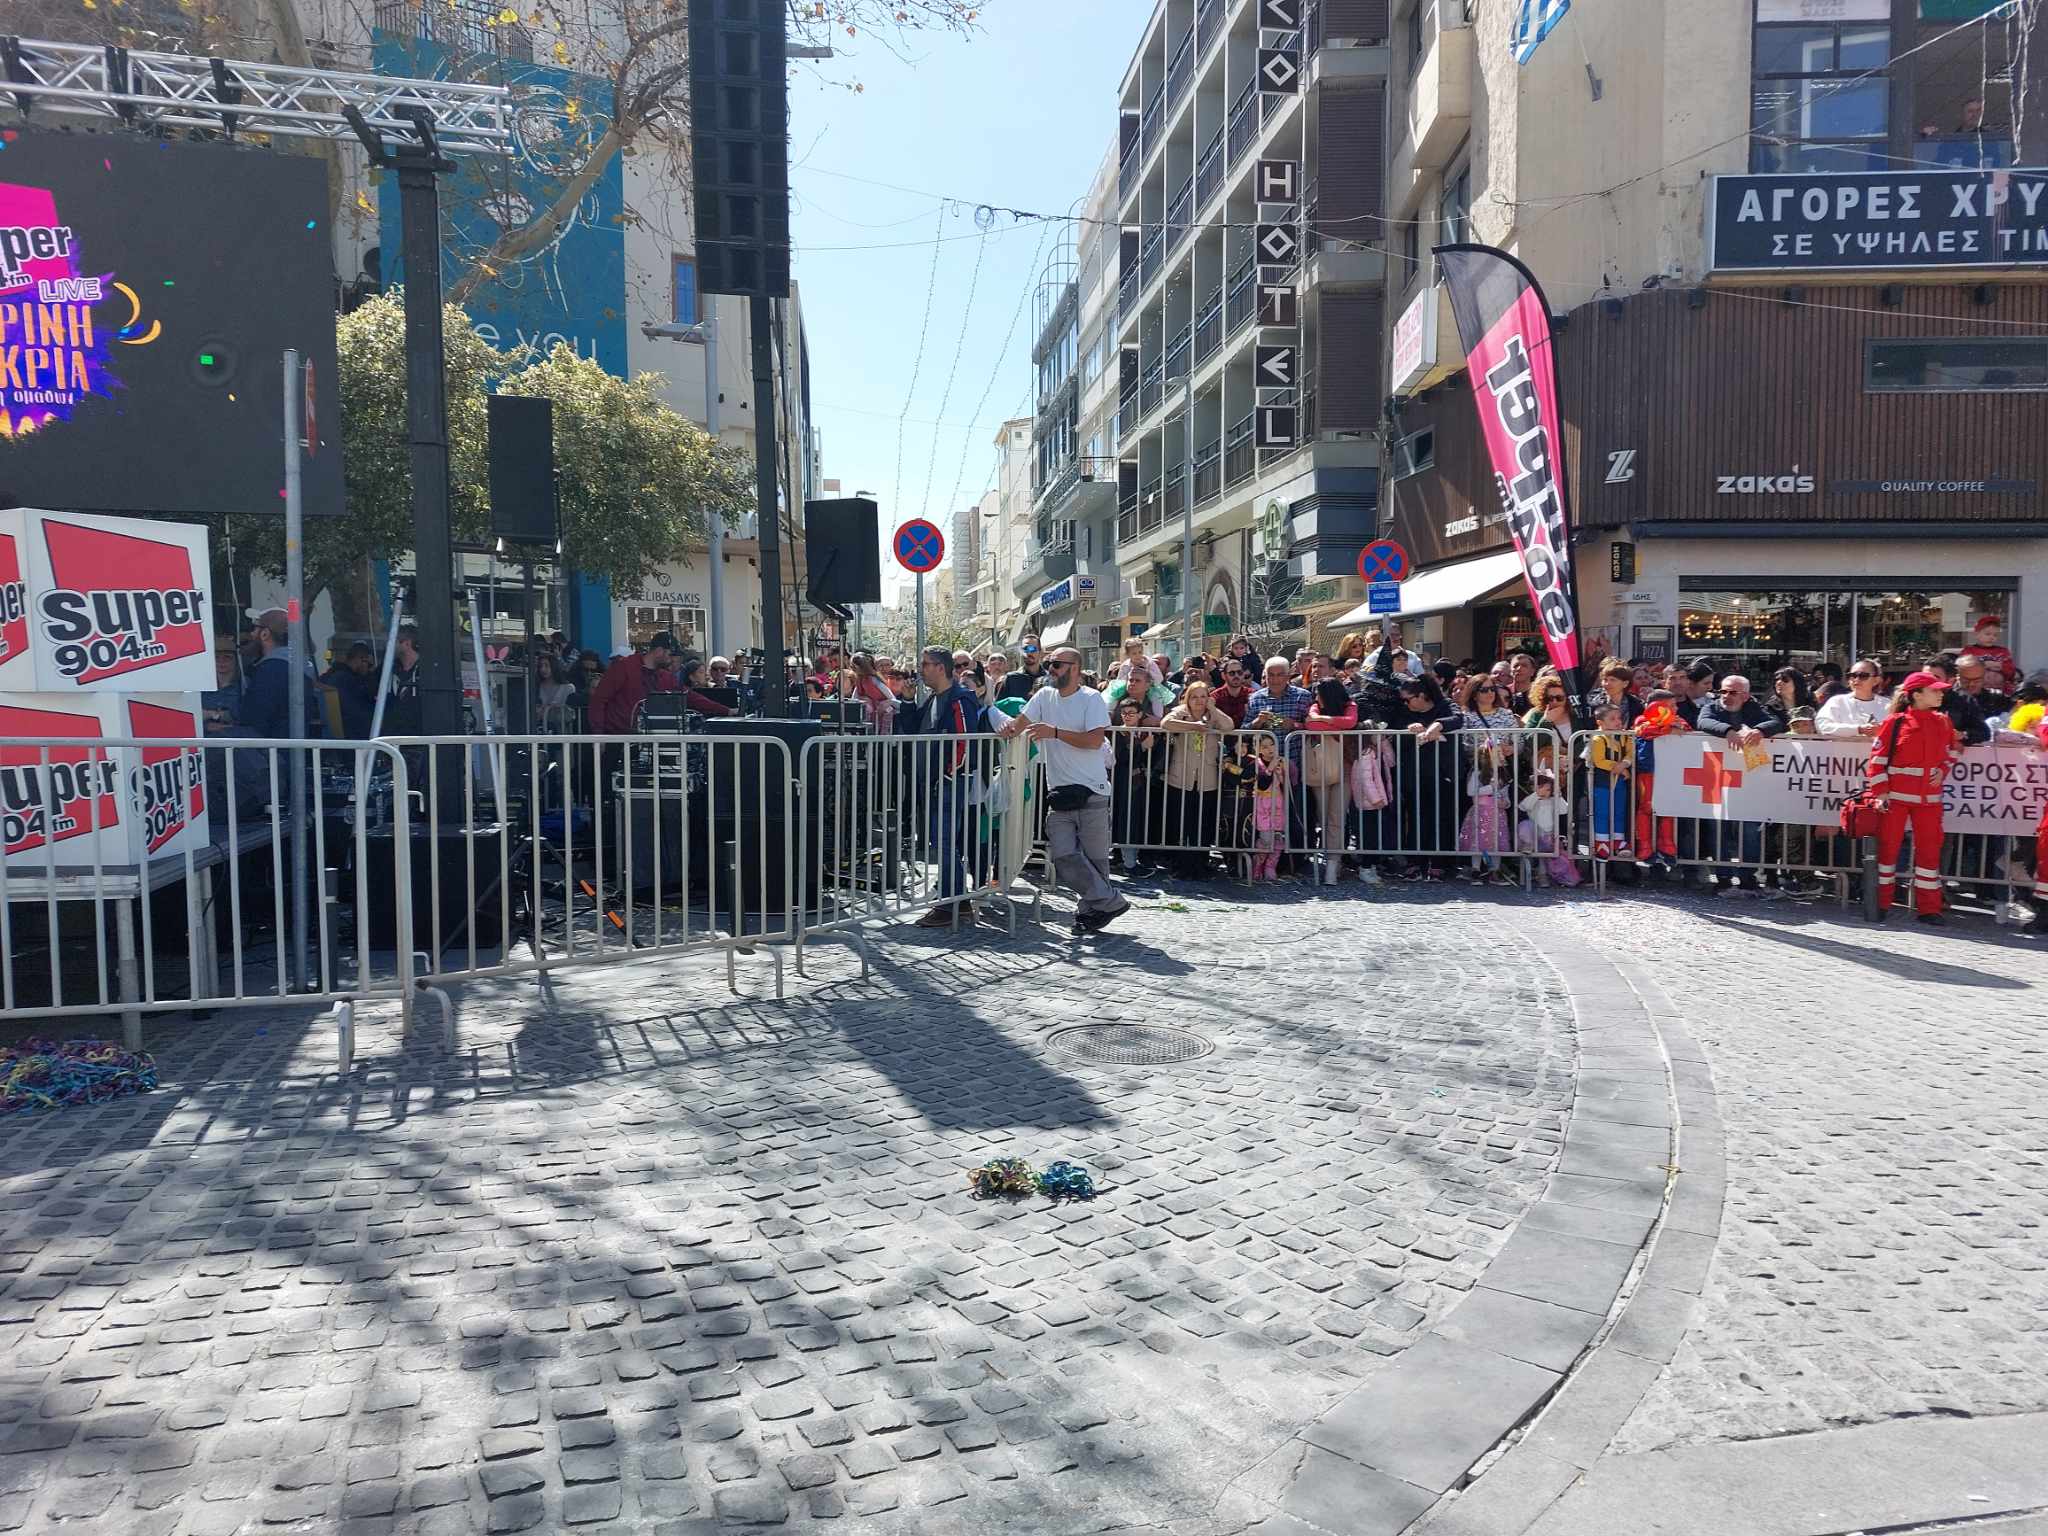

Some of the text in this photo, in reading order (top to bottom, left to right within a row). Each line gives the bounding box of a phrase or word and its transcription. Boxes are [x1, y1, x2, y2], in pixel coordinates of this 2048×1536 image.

[1737, 185, 1921, 222] ΑΓΟΡΕΣ
[1772, 233, 1813, 256] ΣΕ
[1833, 229, 1980, 255] ΥΨΗΛΕΣ
[39, 278, 102, 302] LIVE
[1262, 164, 1294, 443] HOTEL
[1881, 480, 1985, 493] QUALITY COFFEE
[41, 589, 205, 642] Super
[1683, 614, 1771, 640] CAFE
